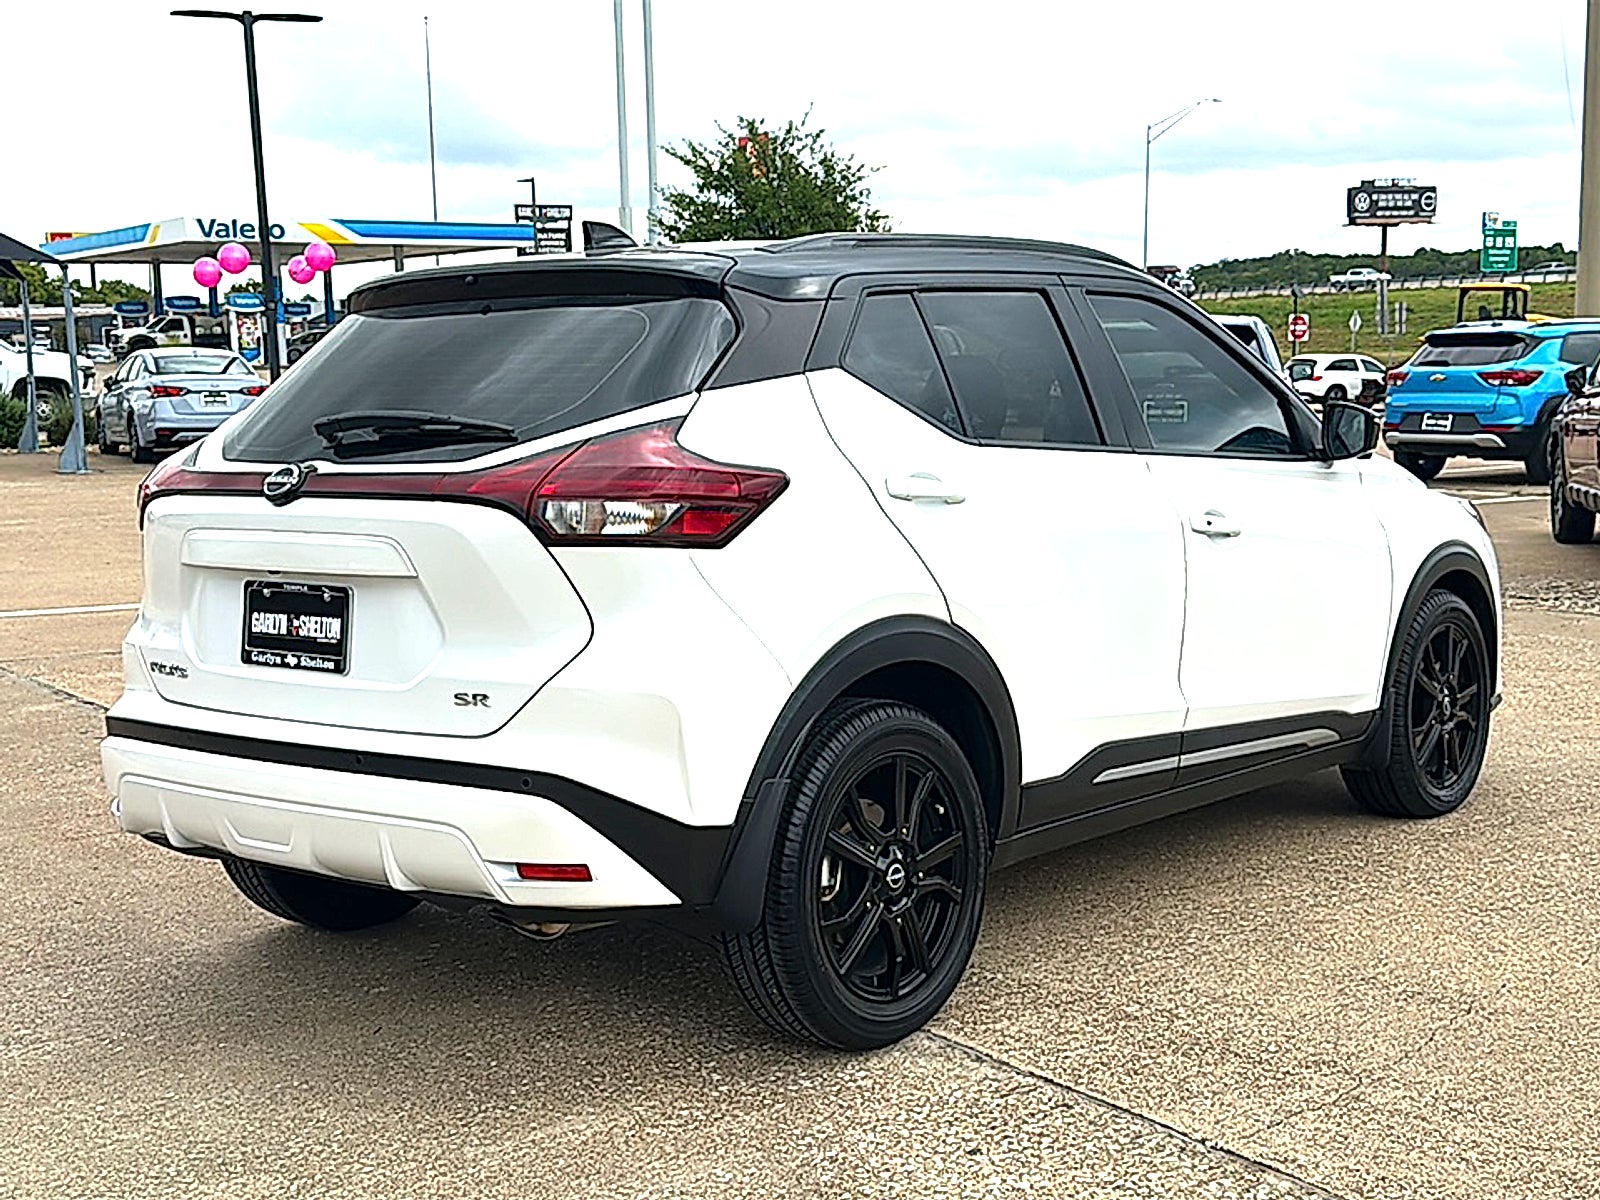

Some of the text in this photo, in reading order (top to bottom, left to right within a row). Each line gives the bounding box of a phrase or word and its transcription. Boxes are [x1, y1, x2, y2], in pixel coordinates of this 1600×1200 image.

[196, 219, 285, 239] Valeo
[299, 615, 341, 639] SHELTON
[300, 656, 335, 670] Shelton
[454, 692, 491, 708] SR
